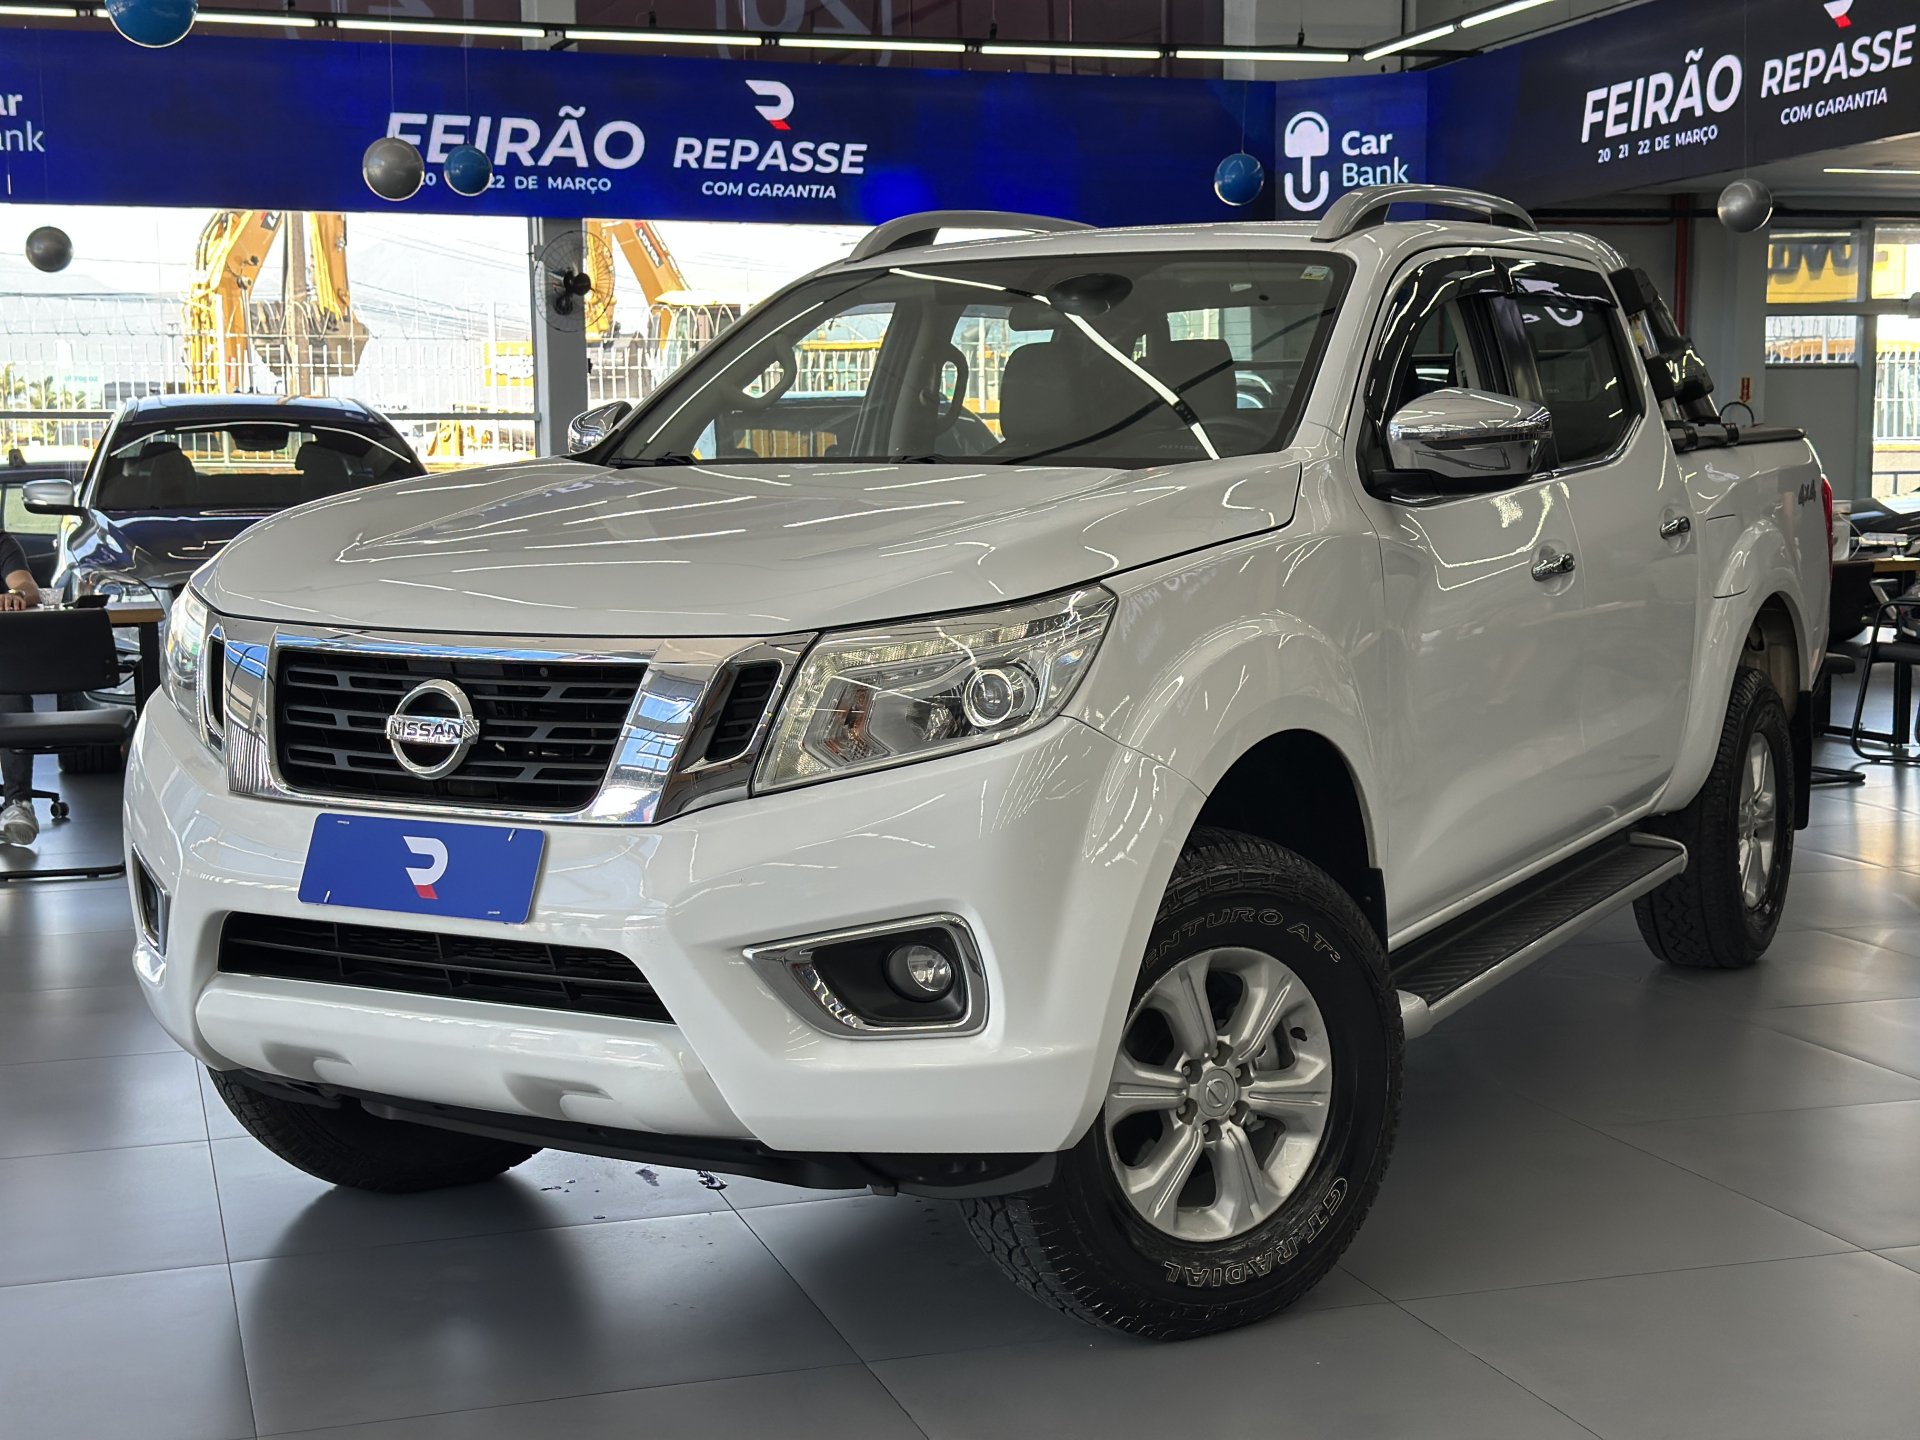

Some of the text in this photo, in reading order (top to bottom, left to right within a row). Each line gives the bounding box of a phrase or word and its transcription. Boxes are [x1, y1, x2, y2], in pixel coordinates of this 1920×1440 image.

[1761, 24, 1917, 98] REPASSE
[1581, 47, 1743, 143] FEIRÃO
[1780, 87, 1888, 125] COM GARANTIA
[0, 120, 46, 152] nk
[386, 105, 646, 169] FEIRÃO
[1341, 130, 1393, 156] Car
[1597, 124, 1718, 163] 20 21 22 DE MARÇO
[673, 136, 868, 175] REPASSE
[1342, 156, 1409, 187] Bank
[514, 175, 538, 189] DE
[548, 176, 612, 194] MARÇO
[701, 181, 837, 199] COM GARANTIA
[389, 720, 464, 739] NISSAN
[1163, 1235, 1299, 1288] RADIAL
